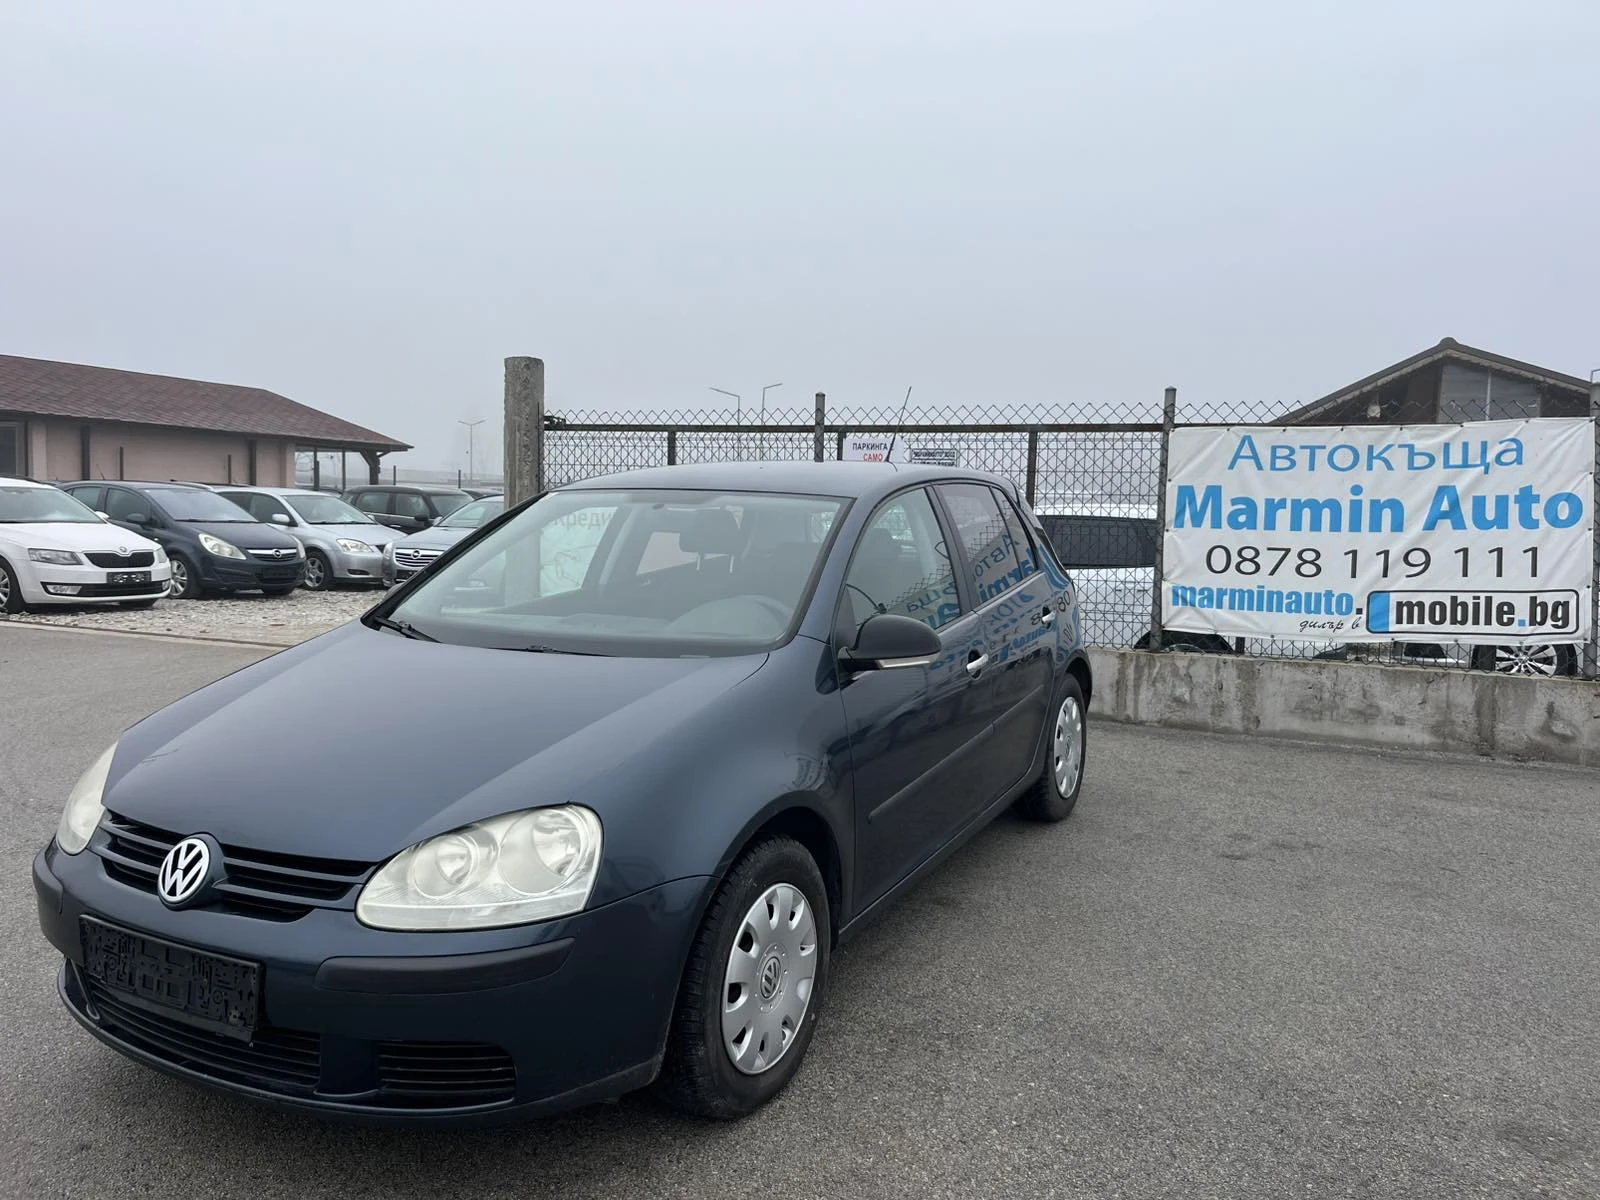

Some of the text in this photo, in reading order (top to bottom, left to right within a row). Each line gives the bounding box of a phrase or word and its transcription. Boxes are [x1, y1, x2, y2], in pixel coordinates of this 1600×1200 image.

[852, 442, 888, 451] ПАРКИНГА
[863, 453, 883, 462] САМО
[1227, 434, 1524, 475] Автокъща
[1173, 484, 1583, 533] Marmin Auto
[1205, 544, 1539, 579] 0878 119 111
[1395, 596, 1571, 629] mobile.bg
